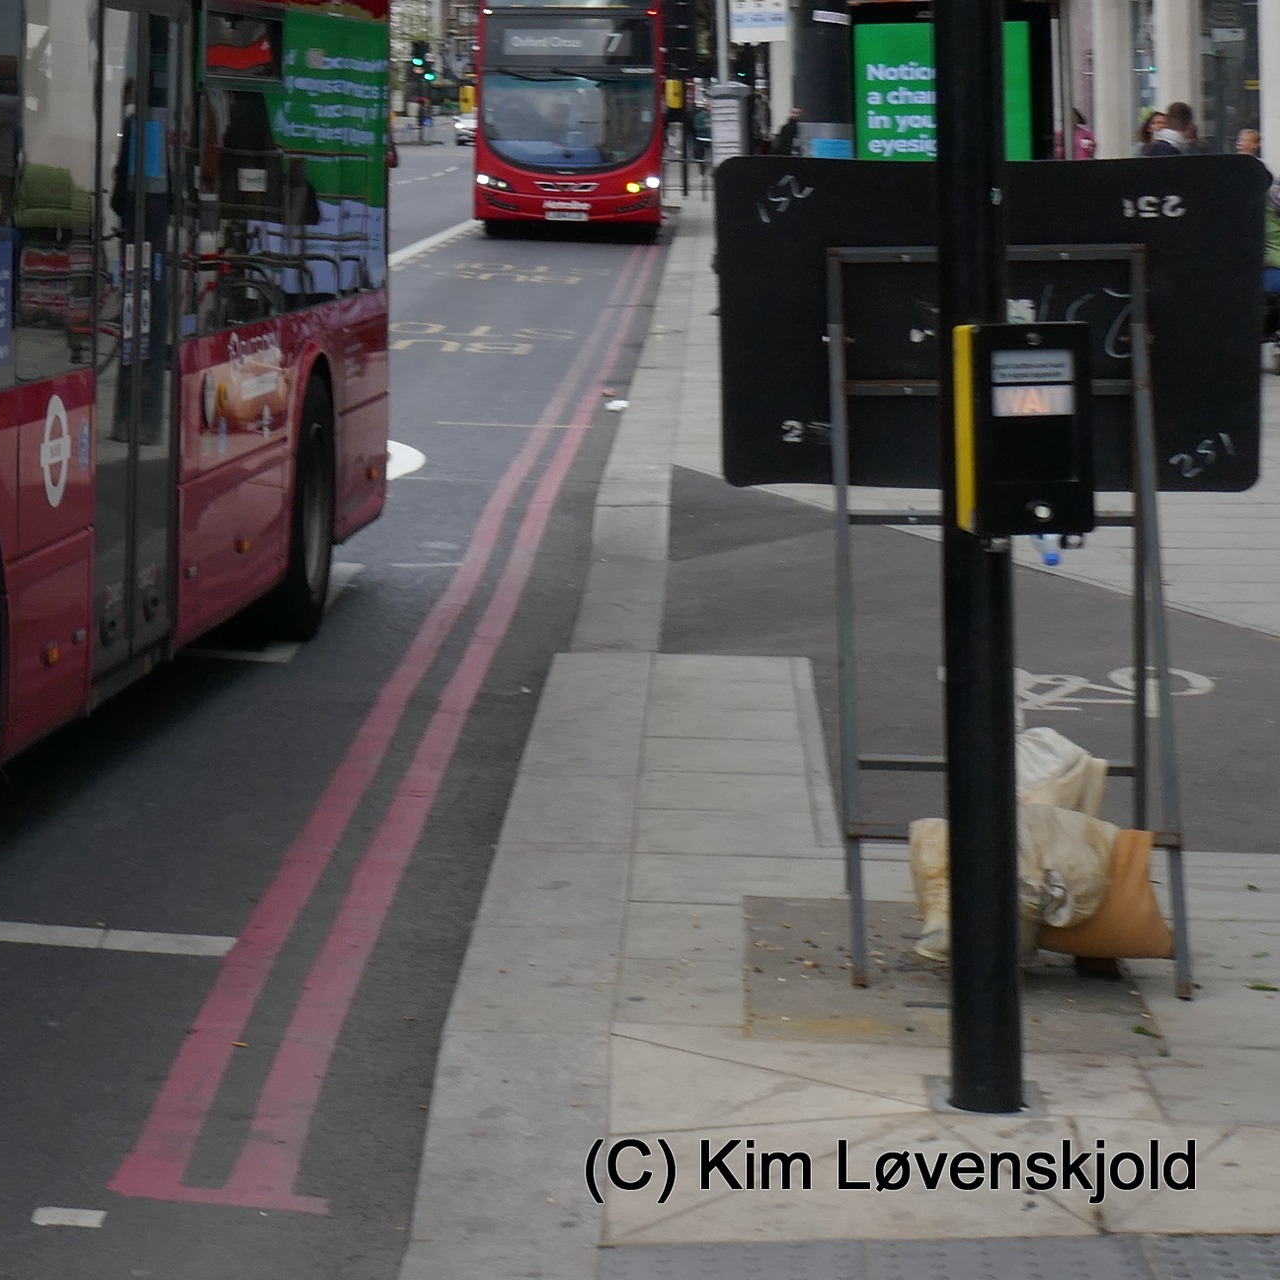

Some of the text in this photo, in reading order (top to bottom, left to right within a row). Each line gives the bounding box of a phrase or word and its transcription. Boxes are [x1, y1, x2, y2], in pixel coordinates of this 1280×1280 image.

[606, 32, 624, 53] 7
[866, 61, 937, 81] Notic
[867, 90, 883, 105] a
[867, 110, 892, 129] in
